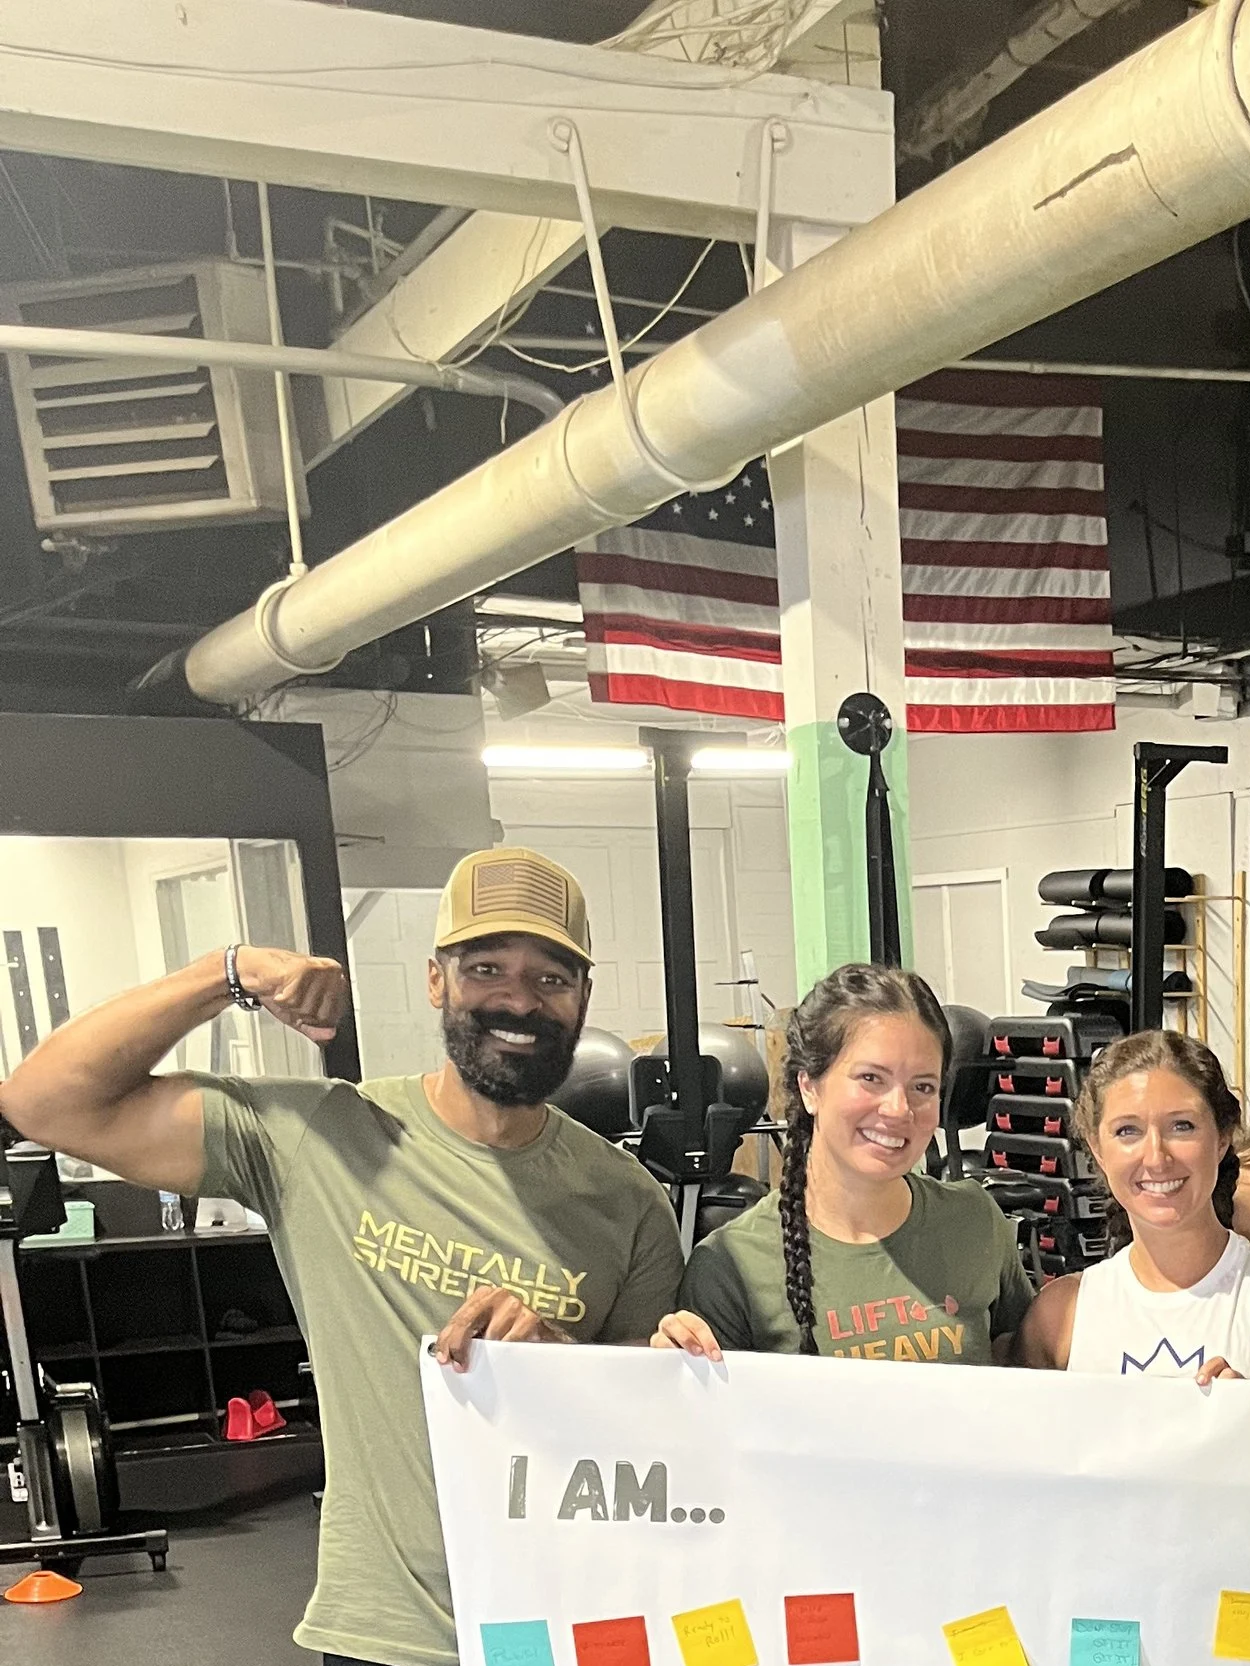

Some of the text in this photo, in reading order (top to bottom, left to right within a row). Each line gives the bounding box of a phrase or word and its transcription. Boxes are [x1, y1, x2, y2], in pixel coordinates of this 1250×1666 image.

[358, 1209, 588, 1297] MENTALLY
[826, 1294, 911, 1341] LIFT
[508, 1455, 725, 1523] I AM...
